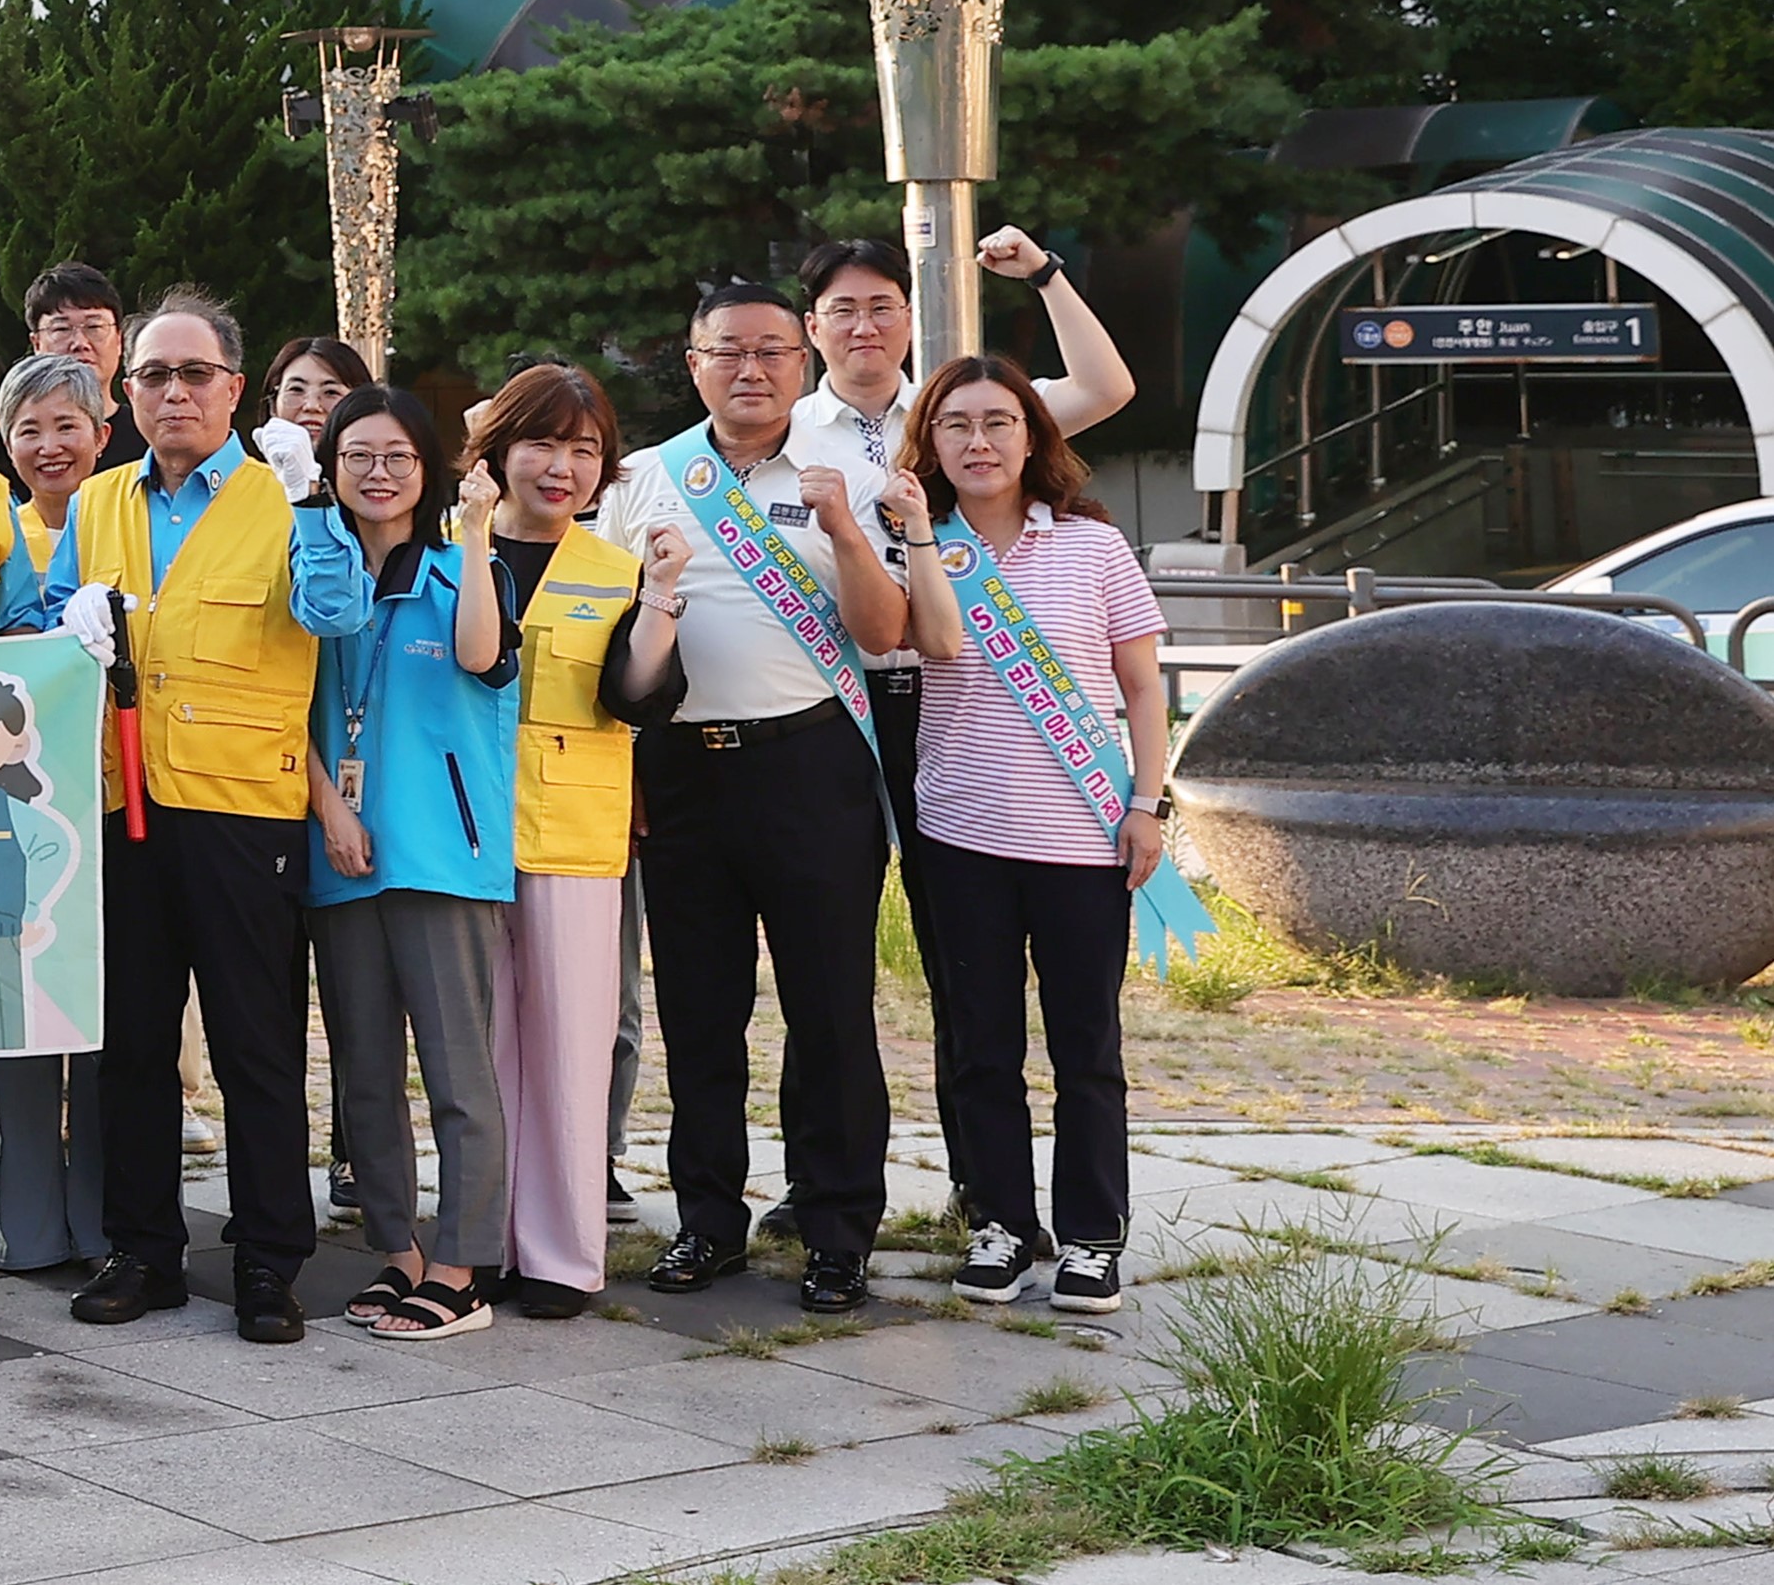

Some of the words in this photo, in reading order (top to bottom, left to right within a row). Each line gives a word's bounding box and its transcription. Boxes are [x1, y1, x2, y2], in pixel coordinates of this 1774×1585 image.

[1458, 318, 1493, 336] 주안
[1498, 321, 1532, 334] Juan
[1625, 317, 1641, 346] 1
[715, 518, 764, 570] 5대
[754, 567, 842, 668] 반칙운전
[834, 665, 870, 718] 근절
[724, 487, 766, 533] 공동체
[763, 534, 828, 611] 신뢰회복을
[967, 603, 1018, 660] 5대
[1005, 660, 1095, 770] 반칙운전
[1082, 769, 1126, 826] 근절
[982, 576, 1025, 624] 공동체
[1018, 627, 1084, 711] 신뢰회복을
[1077, 714, 1108, 748] 위한
